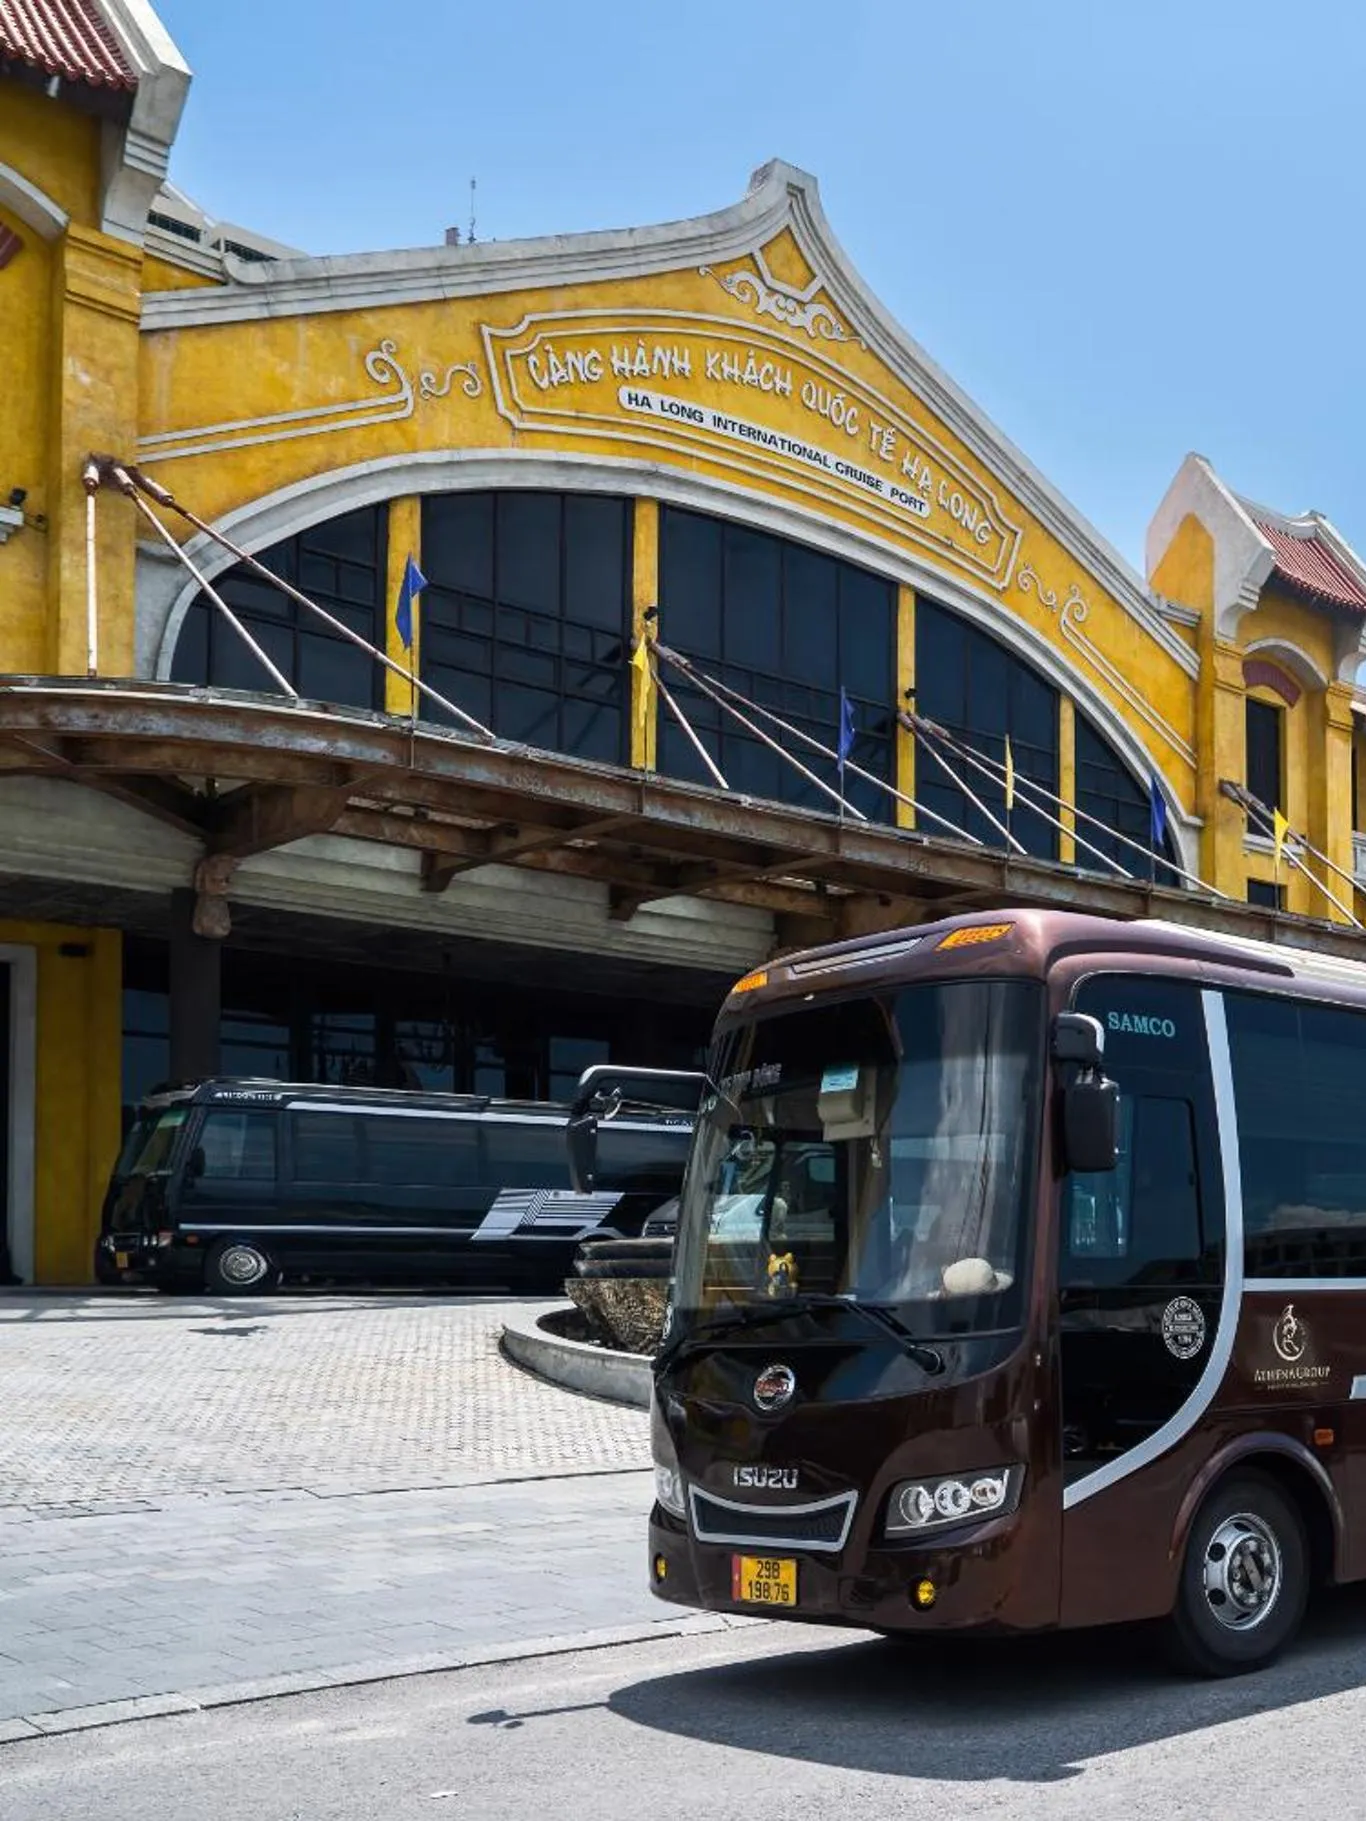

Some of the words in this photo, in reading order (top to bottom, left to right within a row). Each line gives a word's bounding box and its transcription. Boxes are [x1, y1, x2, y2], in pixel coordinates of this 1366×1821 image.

[610, 337, 692, 380] HÀNH
[705, 349, 793, 397] KHÁCH
[802, 379, 859, 436] QUỐC
[937, 480, 992, 544] LONG
[627, 392, 653, 410] HA
[660, 400, 704, 423] LONG
[712, 415, 832, 469] INTERNATIONAL
[835, 461, 884, 493] CRUISE
[890, 487, 926, 513] PORT
[1108, 1011, 1176, 1037] SAMCO
[733, 1466, 798, 1489] ISUZU
[756, 1560, 780, 1579] 29B
